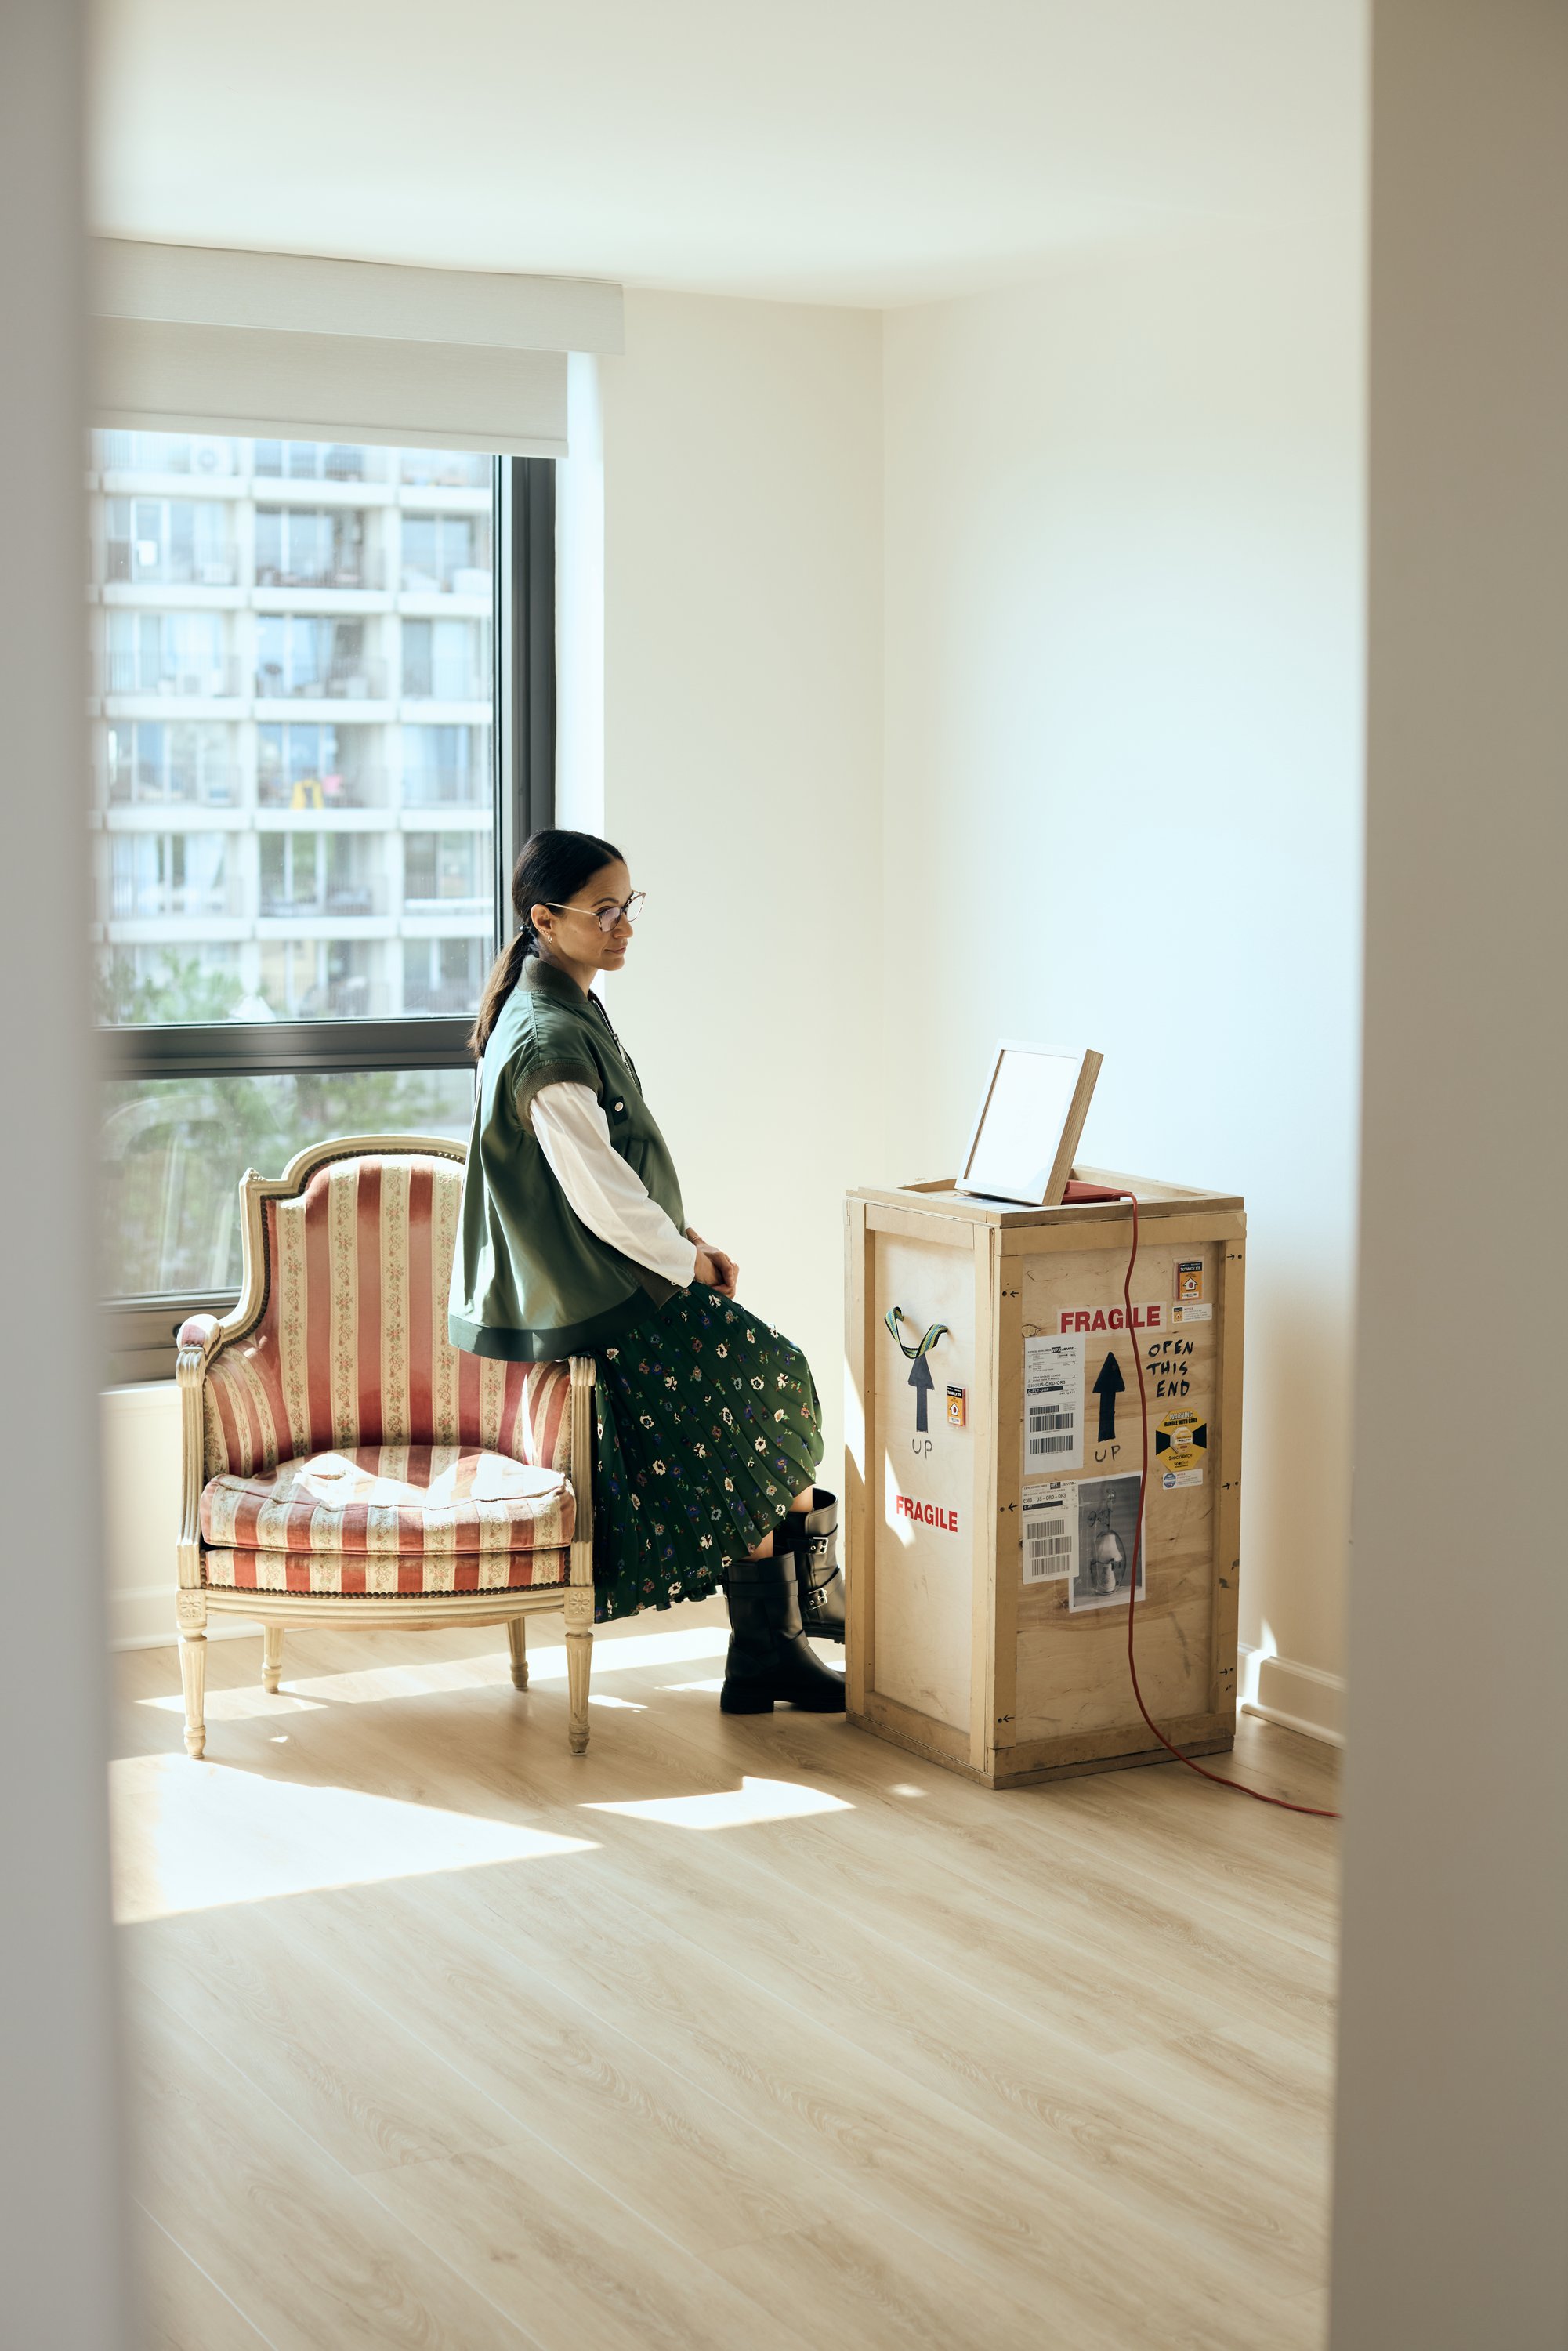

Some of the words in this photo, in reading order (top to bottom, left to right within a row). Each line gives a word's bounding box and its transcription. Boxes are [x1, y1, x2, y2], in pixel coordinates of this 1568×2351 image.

[1148, 1339, 1193, 1357] OPEN
[1146, 1361, 1188, 1376] THIS
[1156, 1381, 1190, 1398] END
[911, 1438, 932, 1459] UP
[1095, 1445, 1121, 1462] UP
[896, 1494, 958, 1533] FRAGILE
